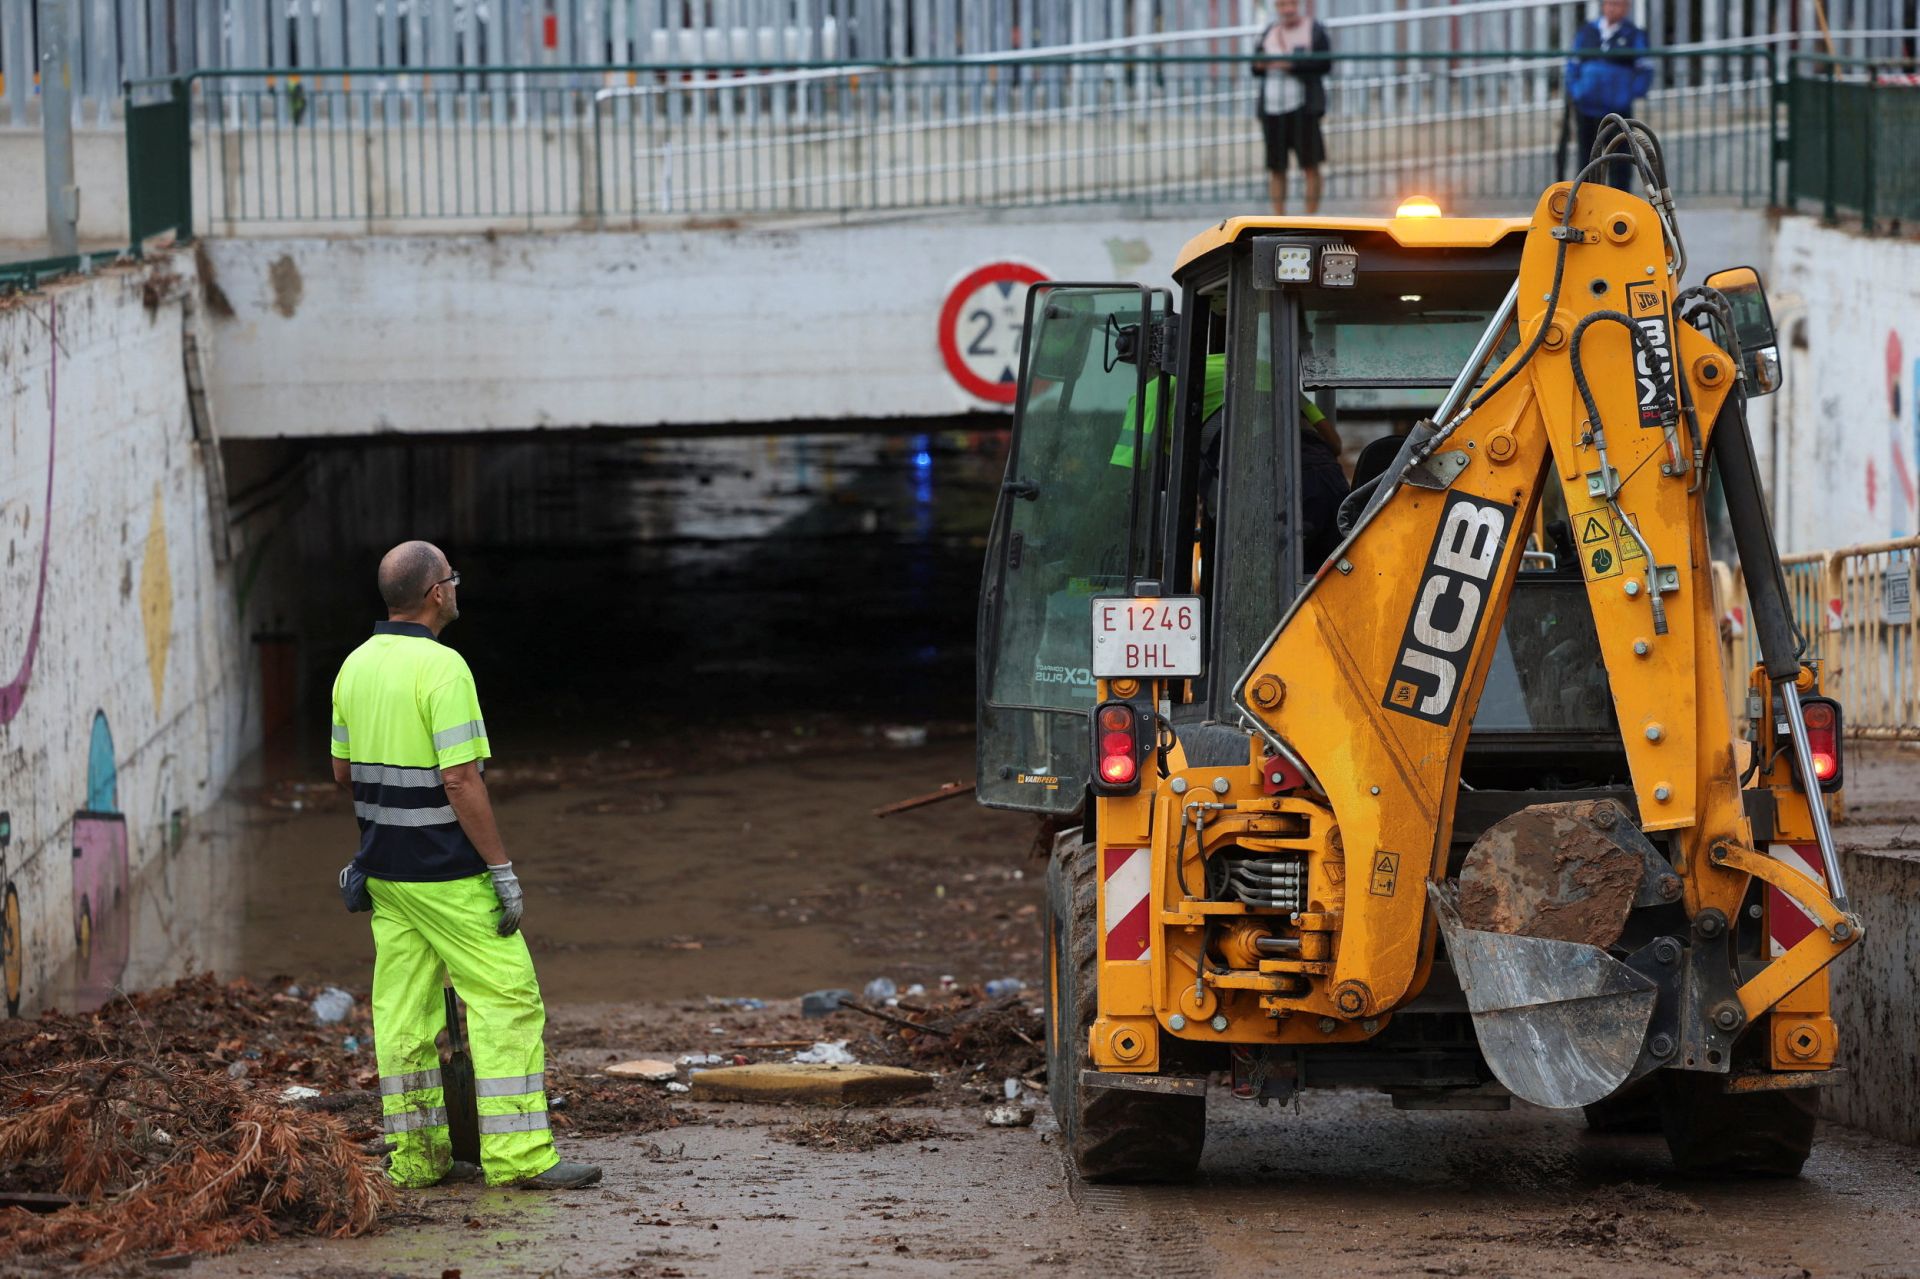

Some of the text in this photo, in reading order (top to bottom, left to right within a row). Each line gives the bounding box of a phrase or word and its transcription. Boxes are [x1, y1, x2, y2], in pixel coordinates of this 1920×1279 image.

[1638, 293, 1659, 309] JCB
[967, 309, 996, 356] 2
[1402, 501, 1505, 716] JCB
[1126, 644, 1176, 669] BHL
